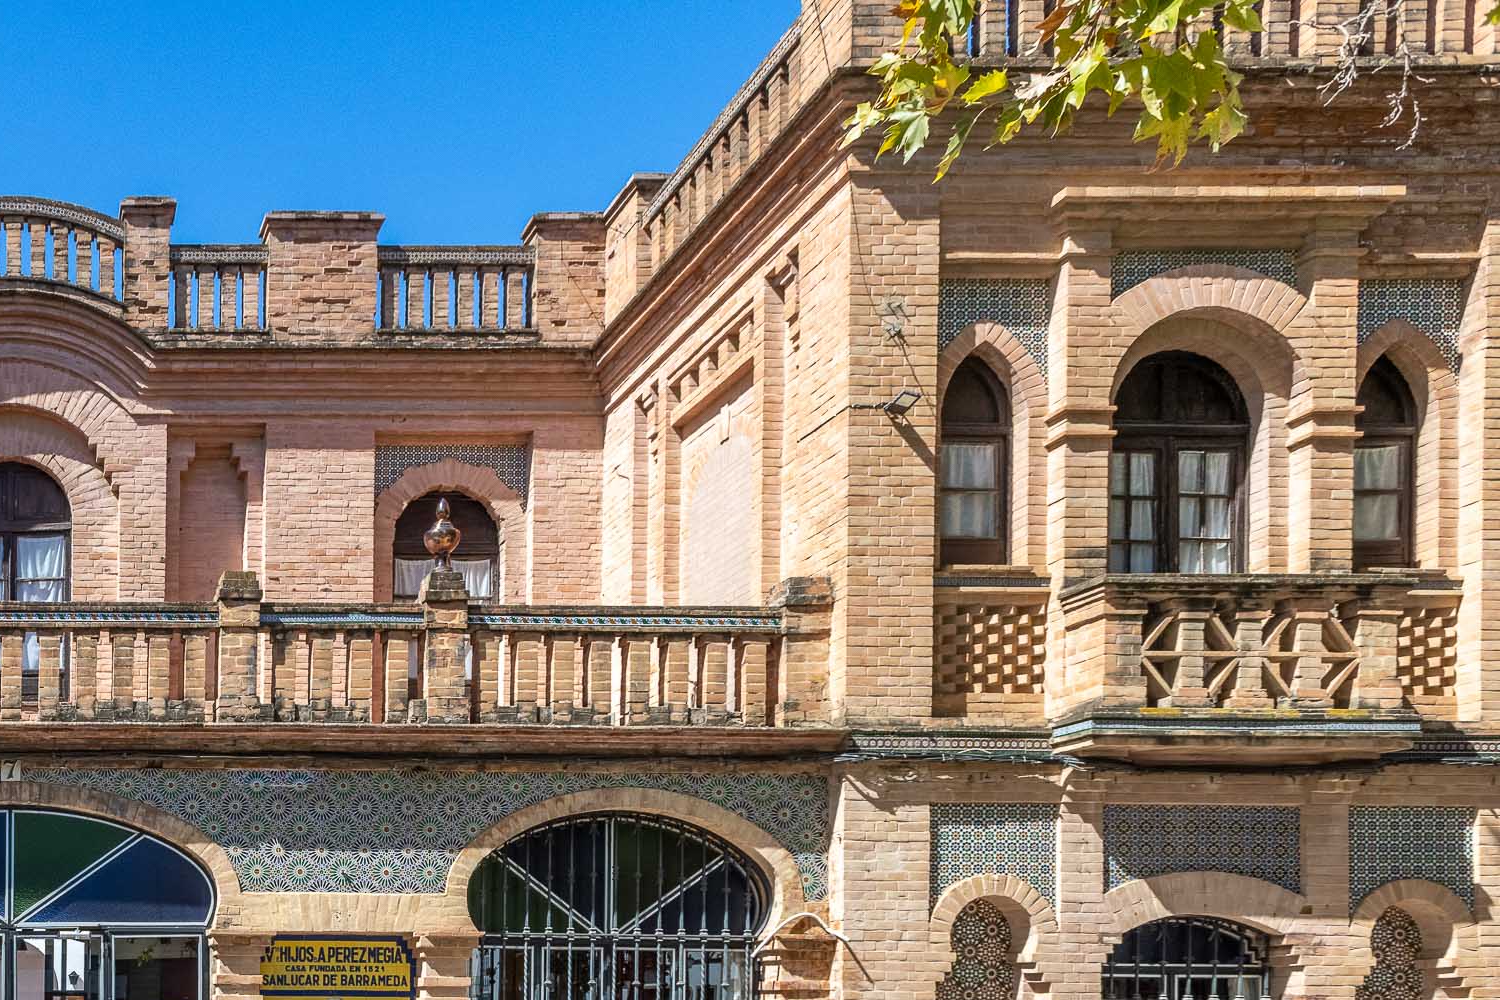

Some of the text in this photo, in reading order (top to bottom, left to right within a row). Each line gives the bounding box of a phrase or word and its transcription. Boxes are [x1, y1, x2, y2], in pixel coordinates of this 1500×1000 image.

[3, 759, 18, 779] 7
[280, 946, 314, 963] HIJOS
[328, 946, 367, 963] PEREZ
[285, 964, 306, 972] CASA
[349, 965, 361, 973] EN
[262, 974, 408, 987] SANLUCAR DE BARRAMEDA
